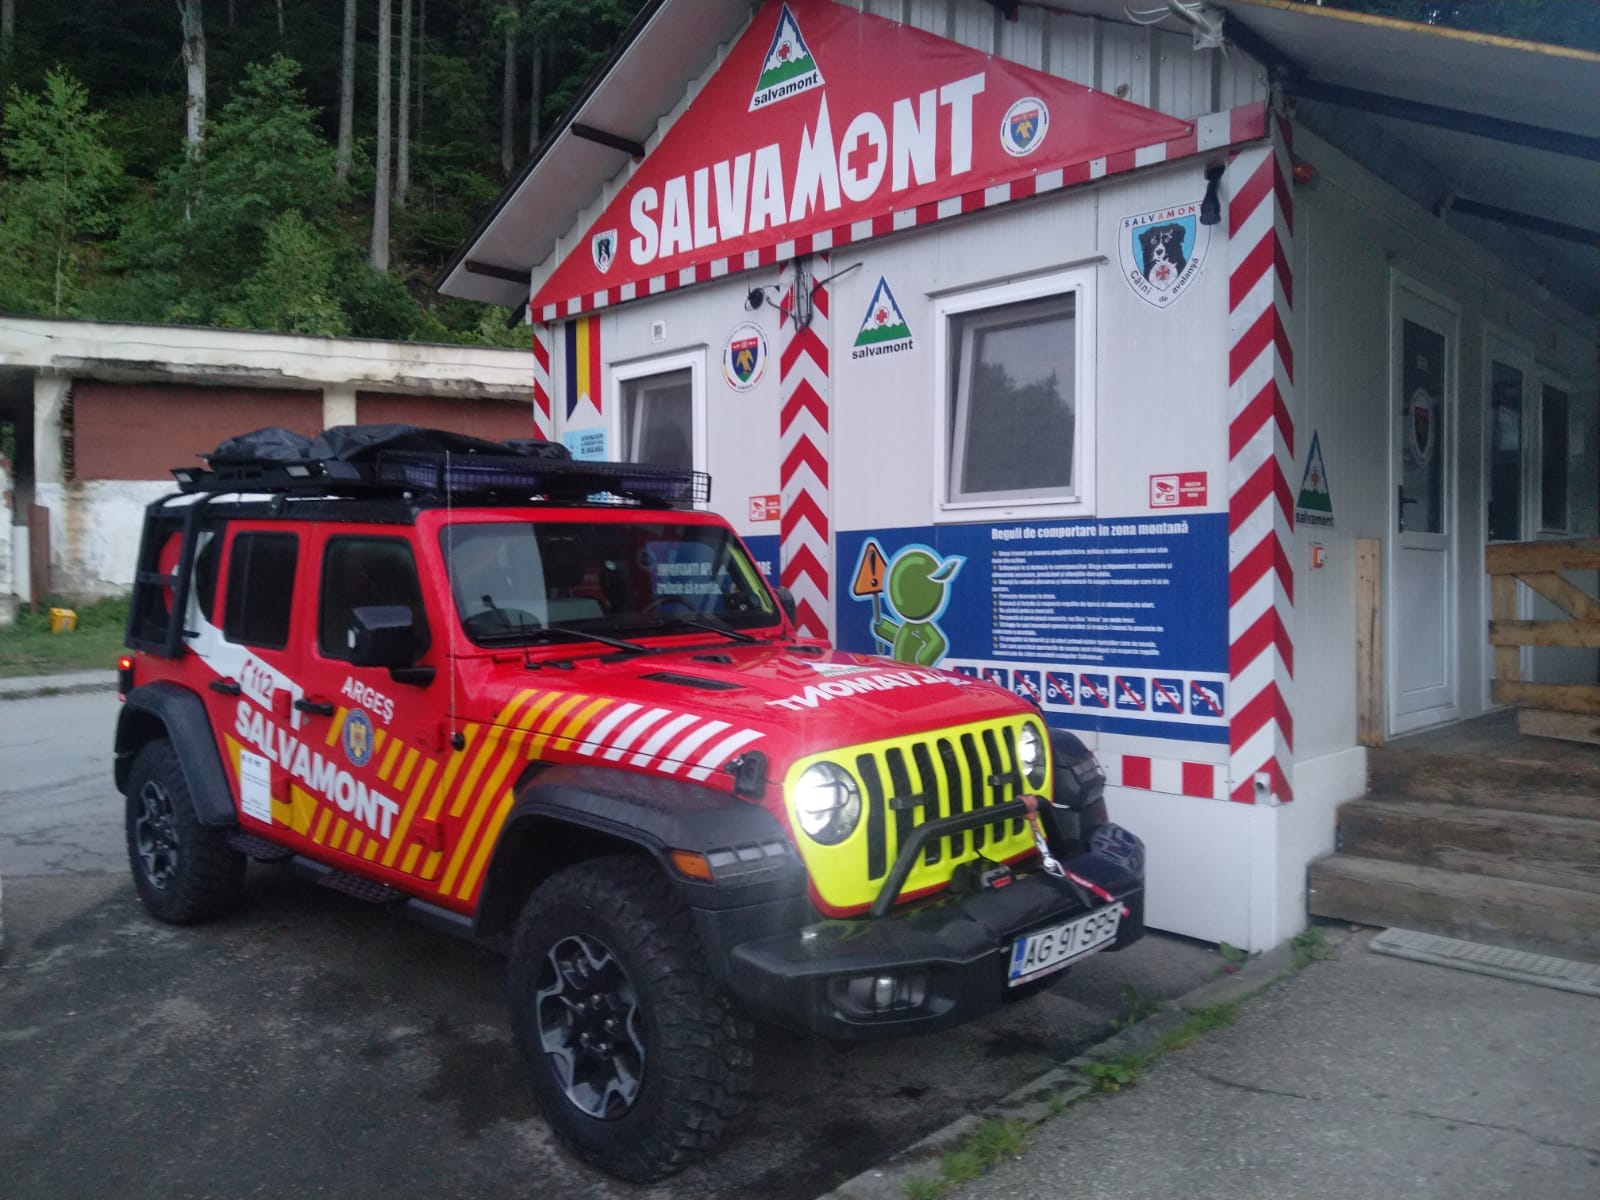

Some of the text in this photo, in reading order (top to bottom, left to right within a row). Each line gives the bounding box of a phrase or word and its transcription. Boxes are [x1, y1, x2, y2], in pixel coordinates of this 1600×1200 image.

[754, 71, 818, 106] salvamont
[630, 72, 985, 266] SALVAMONT
[852, 339, 913, 359] salvamont
[991, 527, 1022, 541] Reguli
[1023, 526, 1036, 539] de
[1037, 525, 1096, 539] comportare
[1111, 524, 1137, 536] zona
[1138, 520, 1189, 535] montană
[251, 666, 273, 699] 112
[341, 676, 394, 725] ARGEȘ
[234, 700, 399, 839] SALVAMONT
[1024, 934, 1054, 968] AG
[1058, 924, 1079, 955] 91
[1081, 907, 1118, 946] SPS
